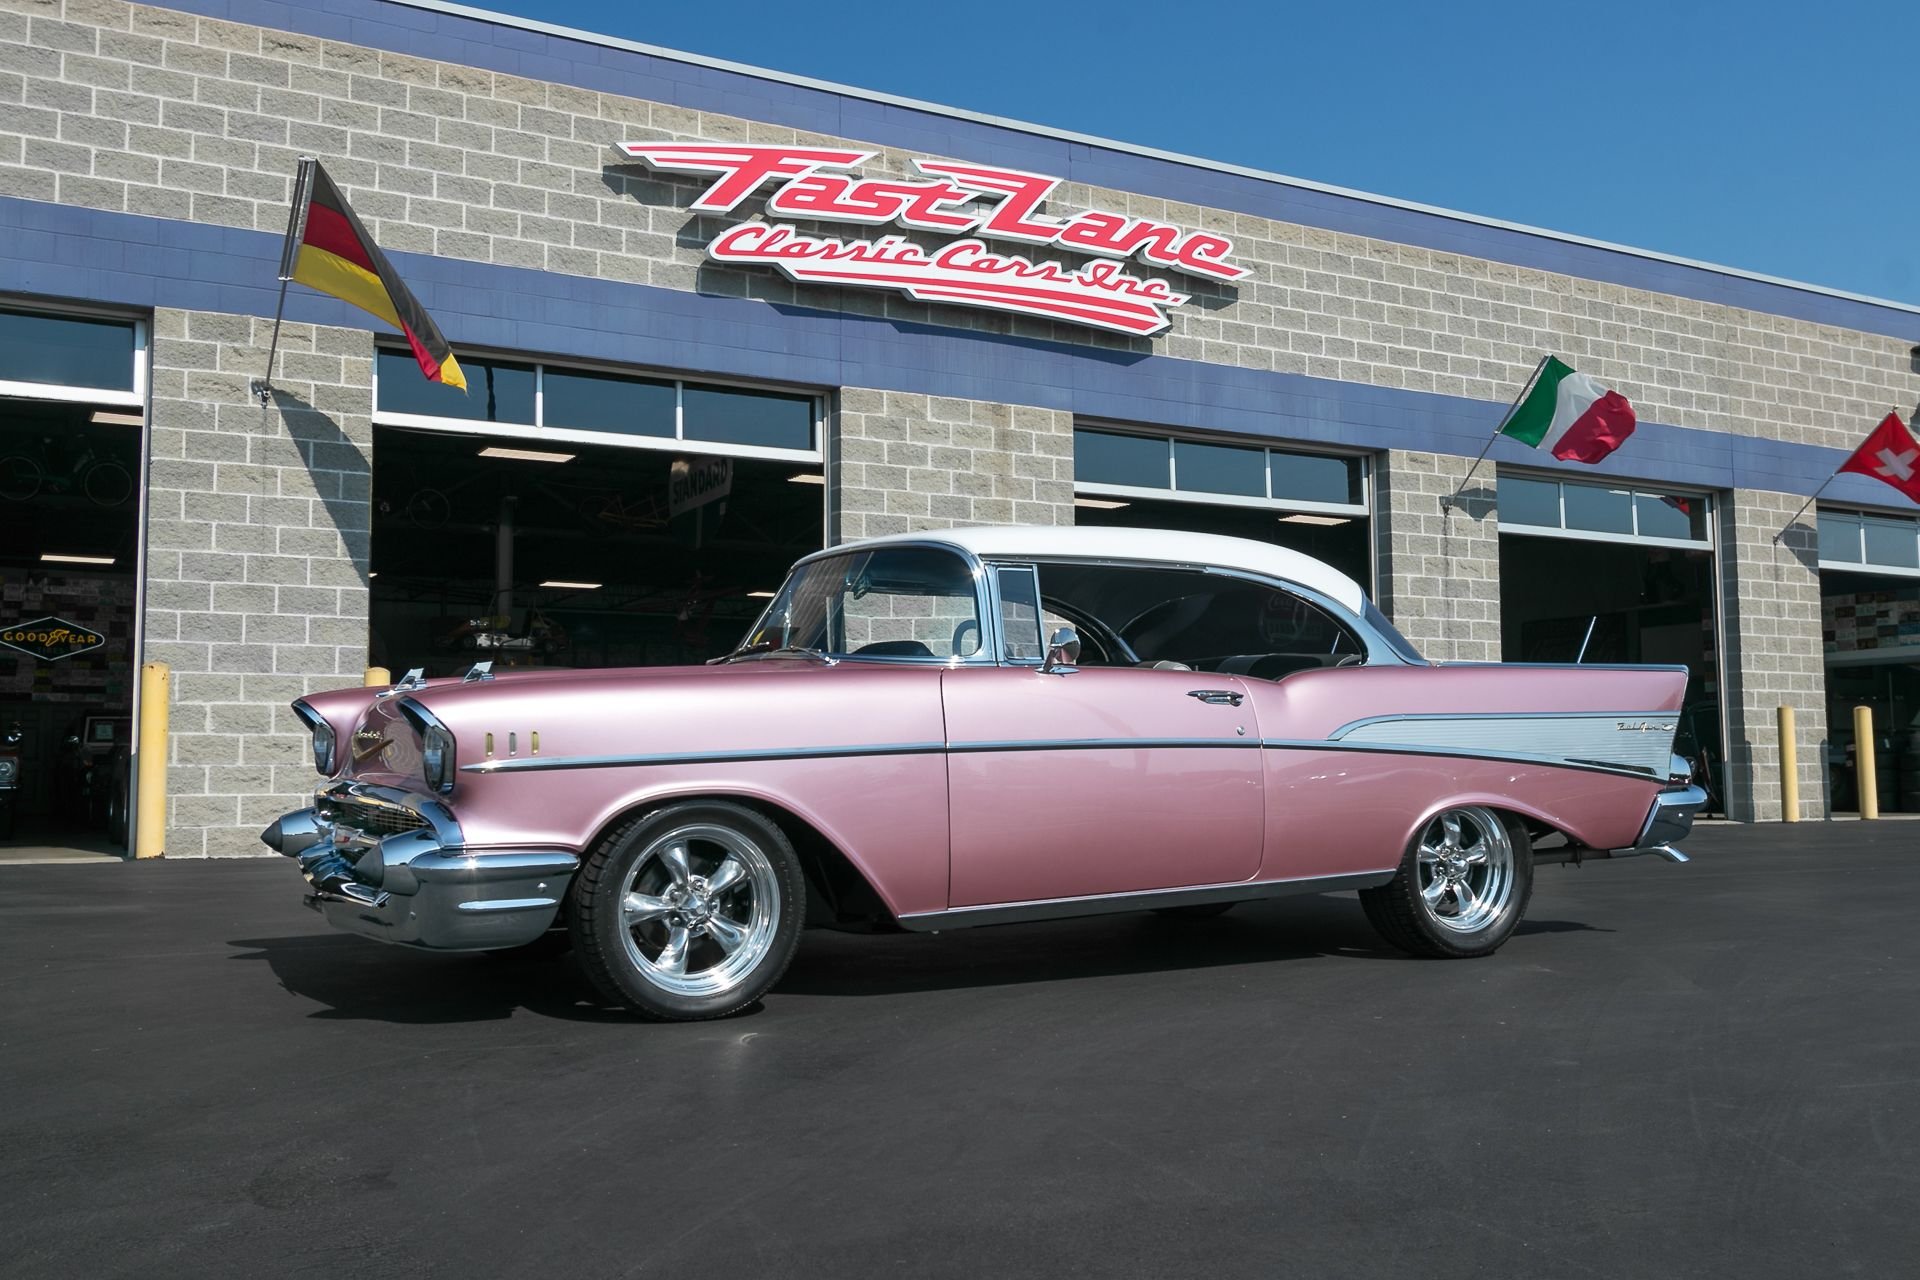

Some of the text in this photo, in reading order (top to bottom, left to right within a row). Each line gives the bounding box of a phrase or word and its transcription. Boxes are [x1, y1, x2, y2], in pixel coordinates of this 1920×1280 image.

[626, 145, 1249, 278] Fast Lane
[713, 226, 1182, 303] Classic Cars Inc.
[672, 458, 728, 505] STANDARD
